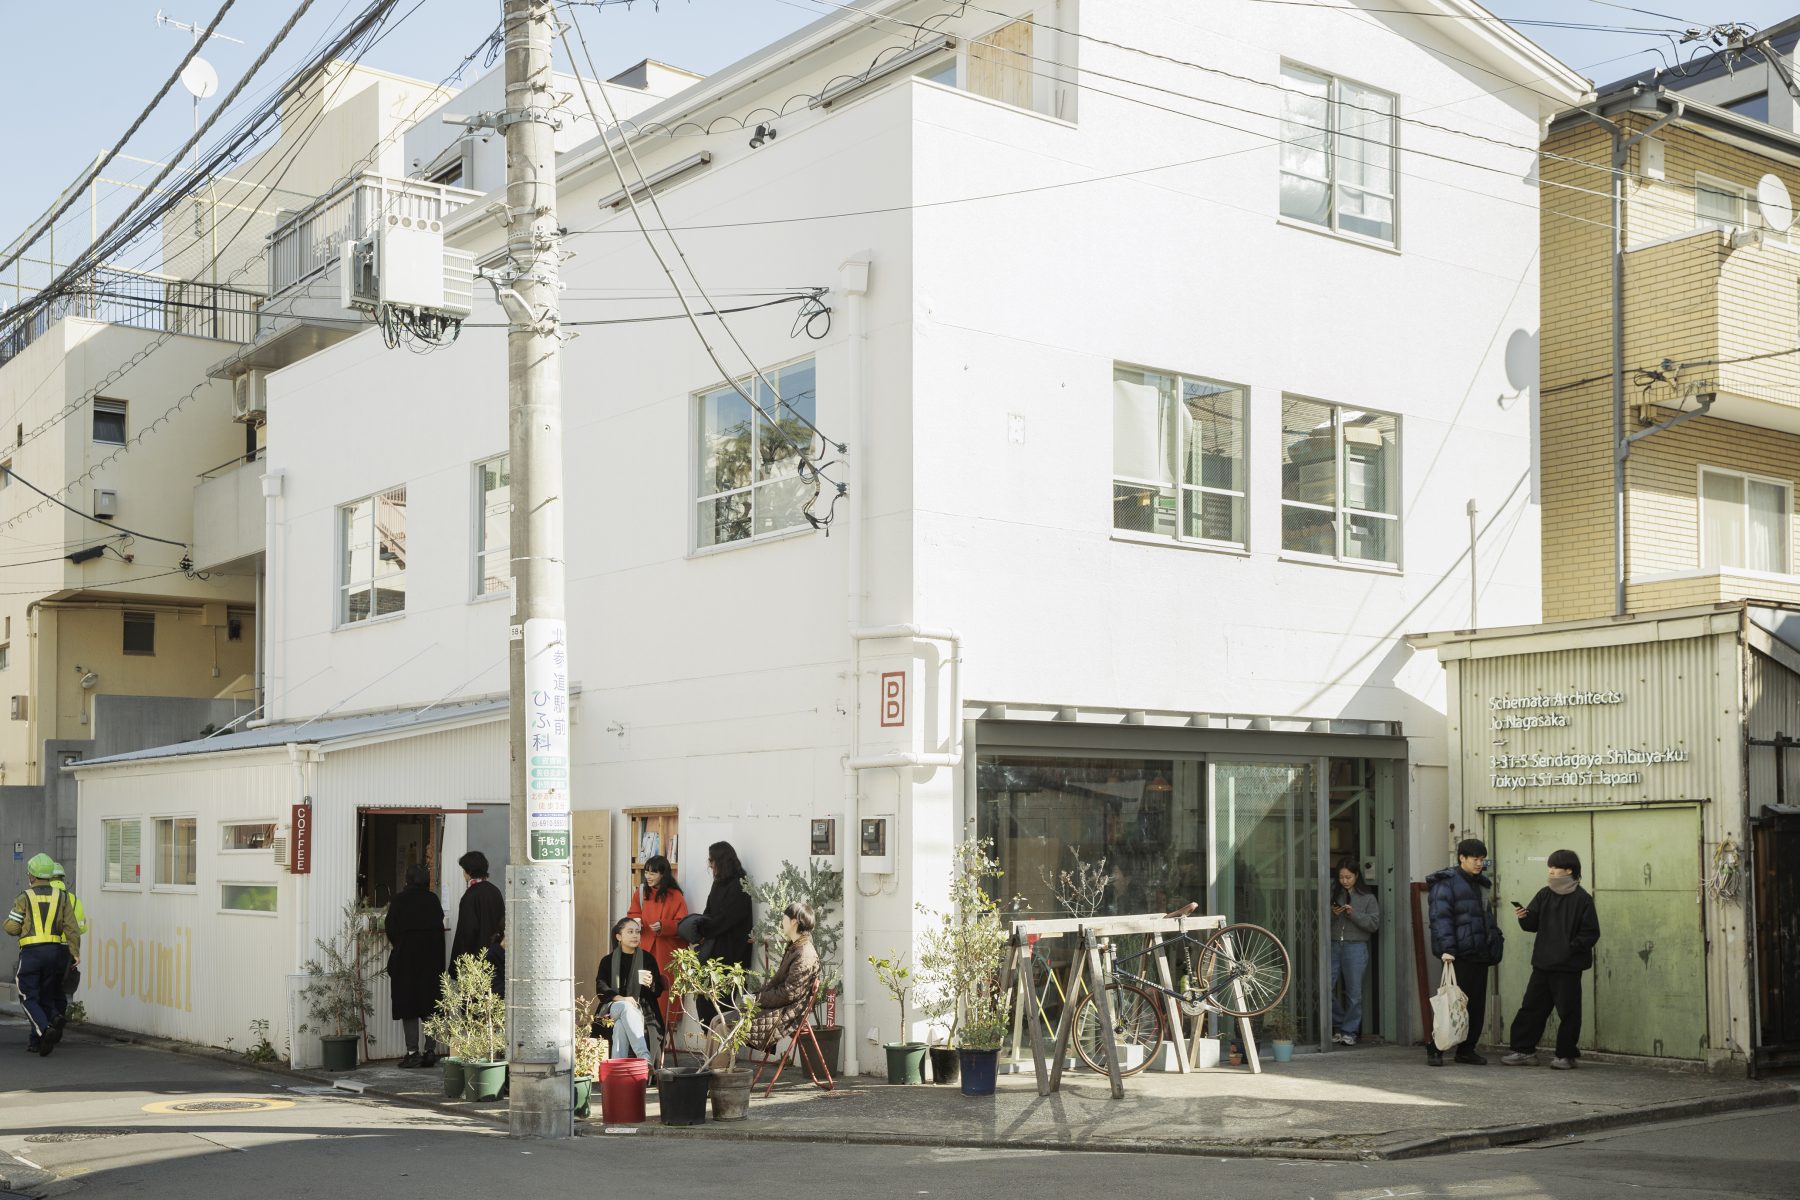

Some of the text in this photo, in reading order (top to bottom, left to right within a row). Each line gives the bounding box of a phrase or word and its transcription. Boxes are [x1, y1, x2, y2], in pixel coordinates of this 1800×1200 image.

[1488, 690, 1621, 710] Schemata Architects
[533, 690, 552, 752] ひふ科
[1489, 712, 1568, 731] Jo Nagasaka
[1531, 752, 1602, 769] Sendagaya
[1607, 747, 1684, 767] Shibuya-ku
[1489, 773, 1527, 790] Tokyo
[1598, 770, 1638, 787] Japan
[297, 808, 305, 871] COFFEE
[541, 848, 565, 857] 3-31
